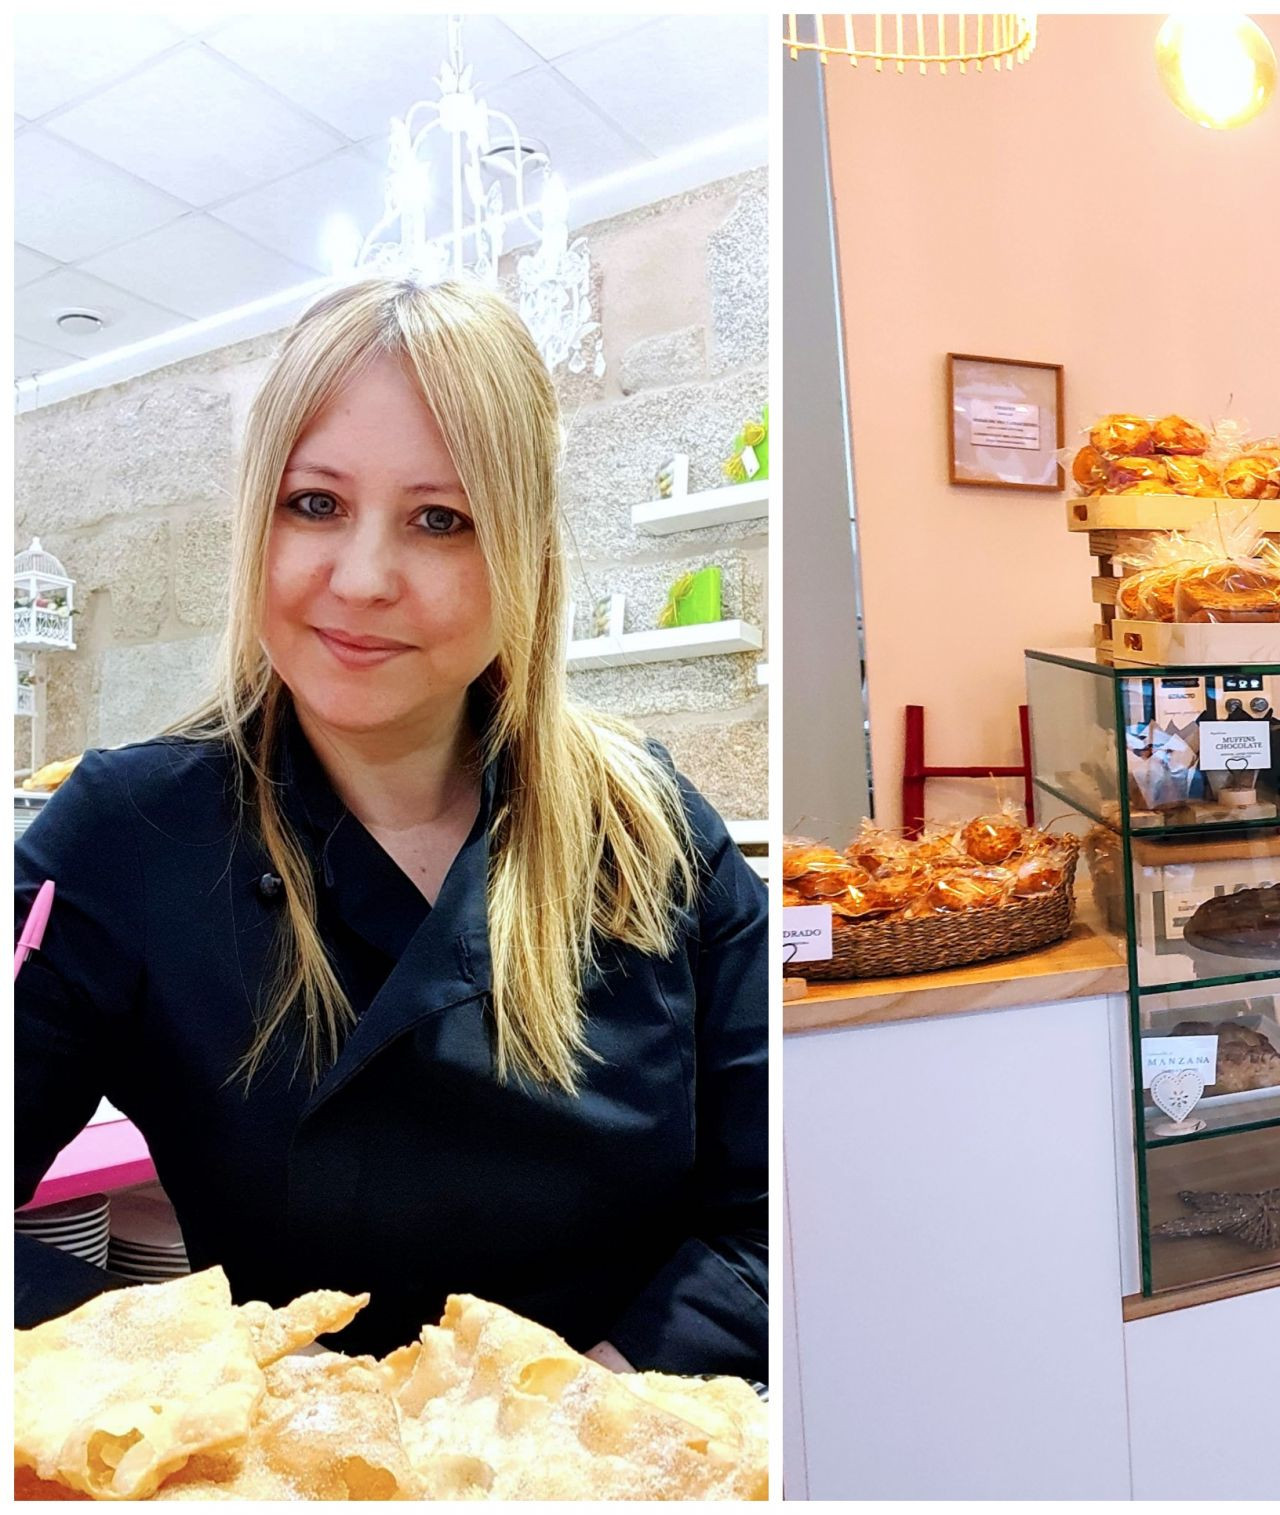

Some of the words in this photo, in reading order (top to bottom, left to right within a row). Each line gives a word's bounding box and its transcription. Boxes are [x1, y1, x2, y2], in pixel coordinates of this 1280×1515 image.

[1221, 736, 1257, 744] MUFFINS
[1215, 741, 1263, 750] CHOCOLATE
[1147, 1056, 1211, 1067] MANZANA
